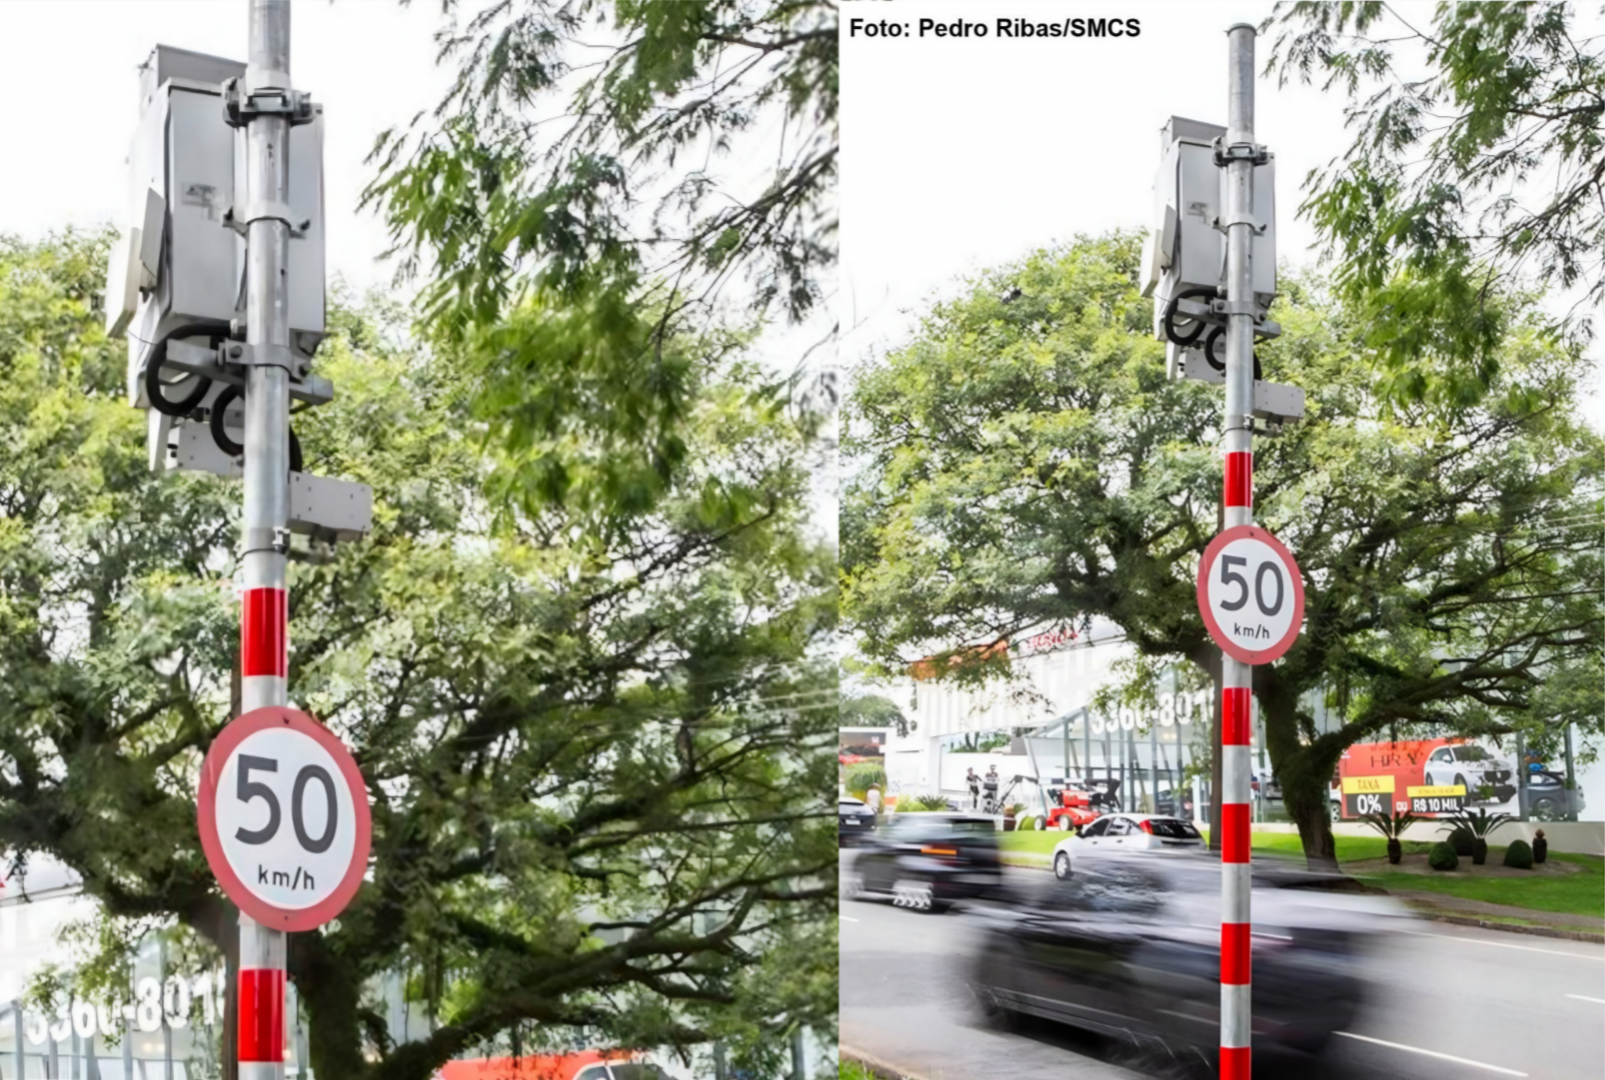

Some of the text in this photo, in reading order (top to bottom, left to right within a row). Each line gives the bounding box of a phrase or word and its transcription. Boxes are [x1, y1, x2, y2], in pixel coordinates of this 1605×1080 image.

[1219, 554, 1284, 617] 50
[1234, 622, 1270, 639] km/h
[234, 753, 338, 854] 50
[1357, 794, 1382, 815] 0%
[1428, 798, 1440, 812] 10
[1441, 797, 1460, 812] MIL
[258, 864, 315, 890] km/h
